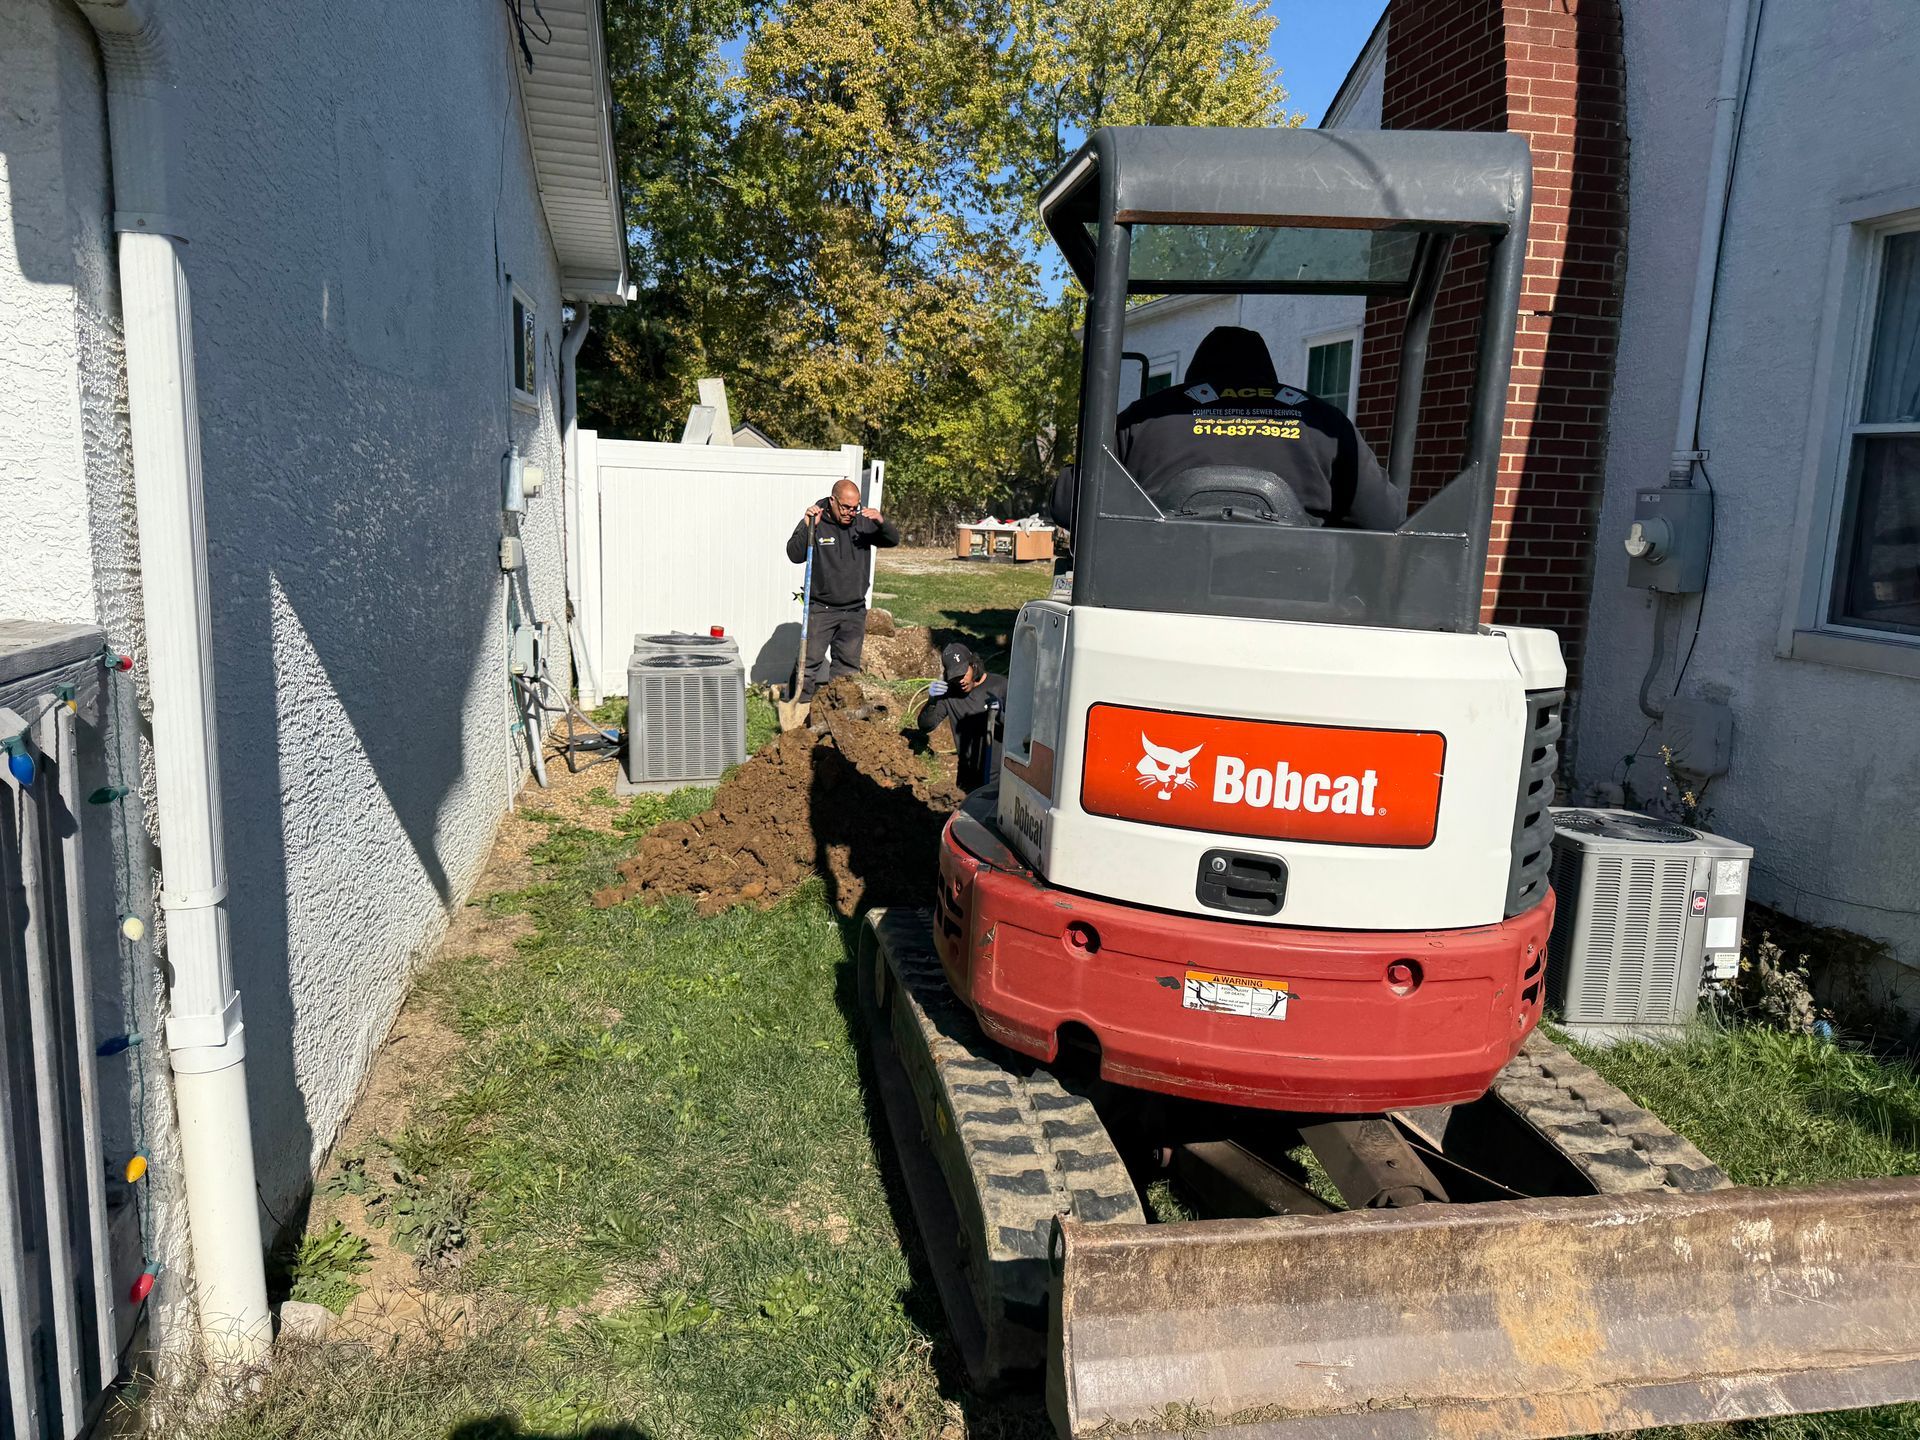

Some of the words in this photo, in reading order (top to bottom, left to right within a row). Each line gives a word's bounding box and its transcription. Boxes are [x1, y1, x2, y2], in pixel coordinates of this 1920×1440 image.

[1220, 388, 1275, 398] ACE
[1224, 408, 1244, 416] SEPTIC
[1273, 409, 1302, 418] SERVICES
[1193, 425, 1300, 439] 614-837-3922
[1213, 755, 1378, 816] Bobcat
[1221, 976, 1263, 988] WARNING
